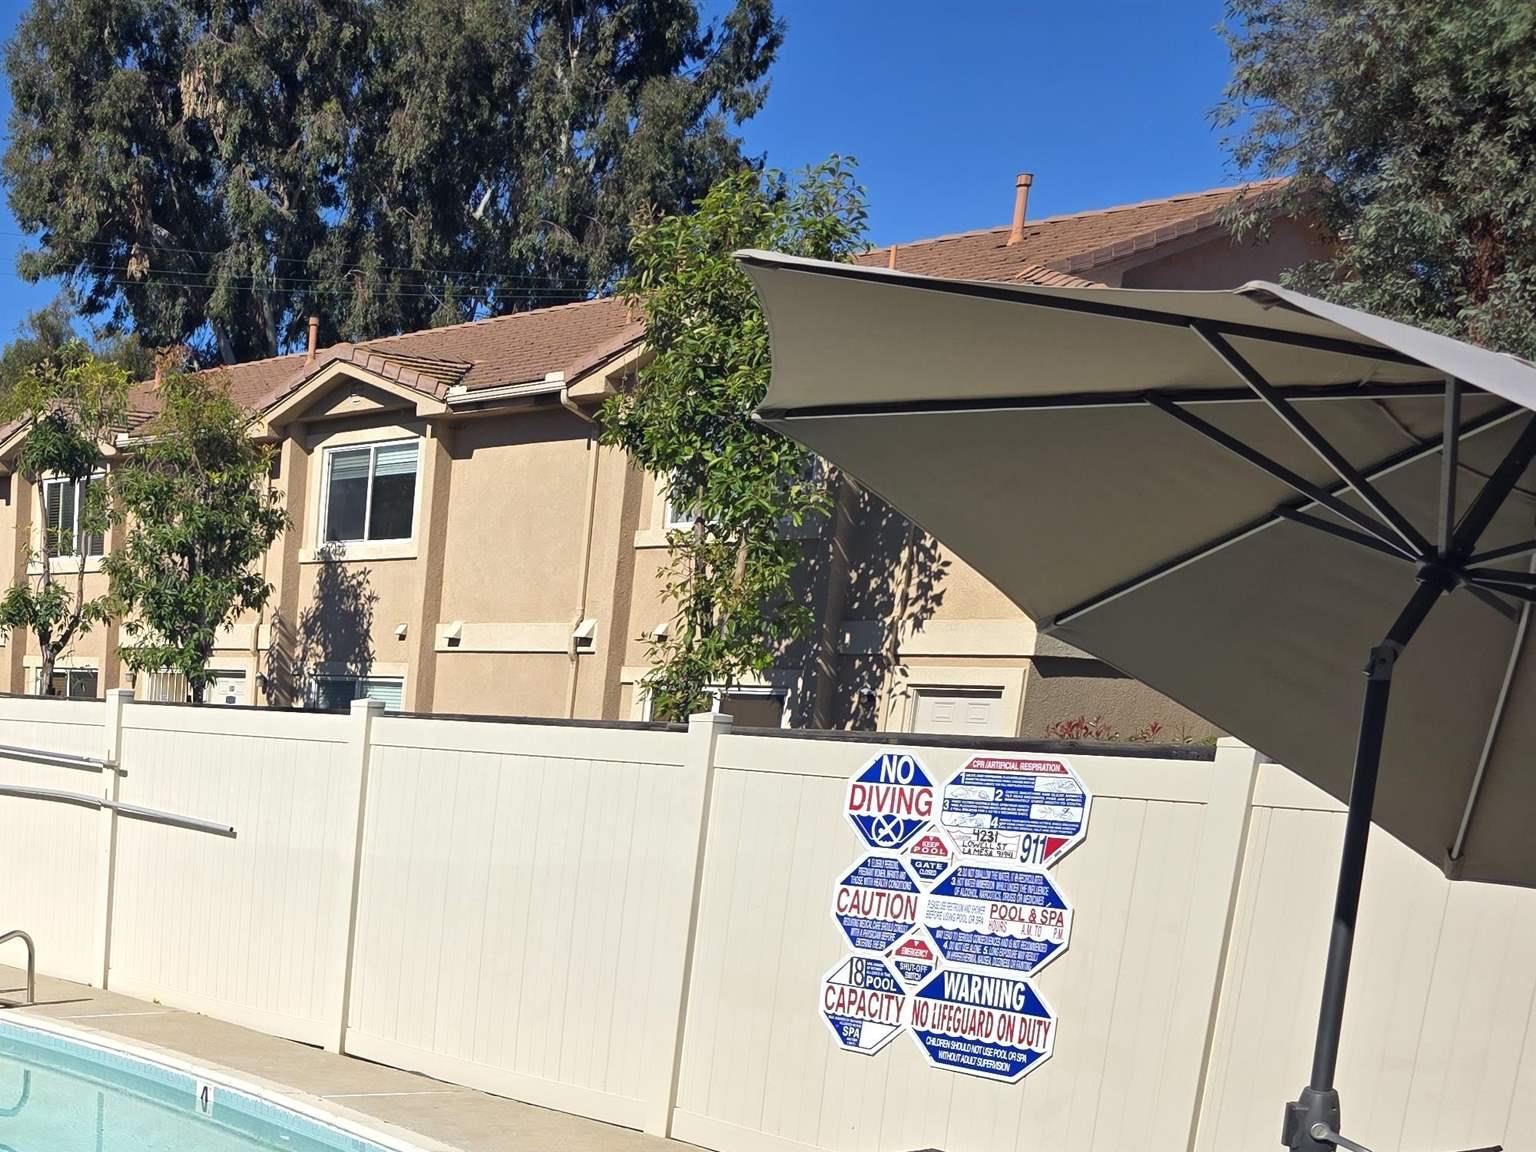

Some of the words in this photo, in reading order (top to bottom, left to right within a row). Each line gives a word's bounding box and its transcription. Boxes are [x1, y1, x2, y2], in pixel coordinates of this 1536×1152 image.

[880, 754, 915, 785] NO
[1020, 762, 1061, 772] RESPIRATION
[960, 773, 965, 784] 1
[849, 784, 933, 817] DIVING
[994, 789, 1004, 801] 2
[944, 800, 950, 810] 3
[990, 817, 999, 829] 4
[973, 829, 999, 843] 4231
[914, 846, 946, 855] POOL
[962, 840, 994, 850] LOWELL
[996, 842, 1008, 850] ST
[1020, 834, 1048, 864] 911
[915, 861, 944, 870] GATE
[919, 868, 937, 877] CLOSED
[837, 887, 918, 921] CAUTION
[990, 903, 1025, 922] POOL
[1028, 908, 1037, 924] &
[1039, 910, 1064, 927] SPA
[988, 920, 1008, 933] HOURS
[849, 957, 864, 986] 18
[899, 962, 928, 973] SHUT-OFF
[866, 975, 897, 992] POOL
[944, 971, 1026, 1012] WARNING
[824, 985, 905, 1023] CAPACITY
[912, 999, 929, 1028] NO
[931, 1002, 994, 1039] LIFEGUARD
[997, 1013, 1015, 1043] ON
[1018, 1016, 1051, 1049] DUTY
[842, 1025, 860, 1039] SPA
[925, 1036, 951, 1049] CHILDREN
[951, 1040, 972, 1053] SHOULD
[972, 1044, 982, 1055] NOT
[982, 1047, 993, 1056] USE
[993, 1048, 1009, 1060] POOL
[1009, 1051, 1017, 1061] OR
[1017, 1053, 1027, 1063] SPA
[938, 1050, 961, 1062] WITHOUT
[960, 1054, 976, 1066] ADULT
[976, 1057, 1011, 1072] SUPERVISION
